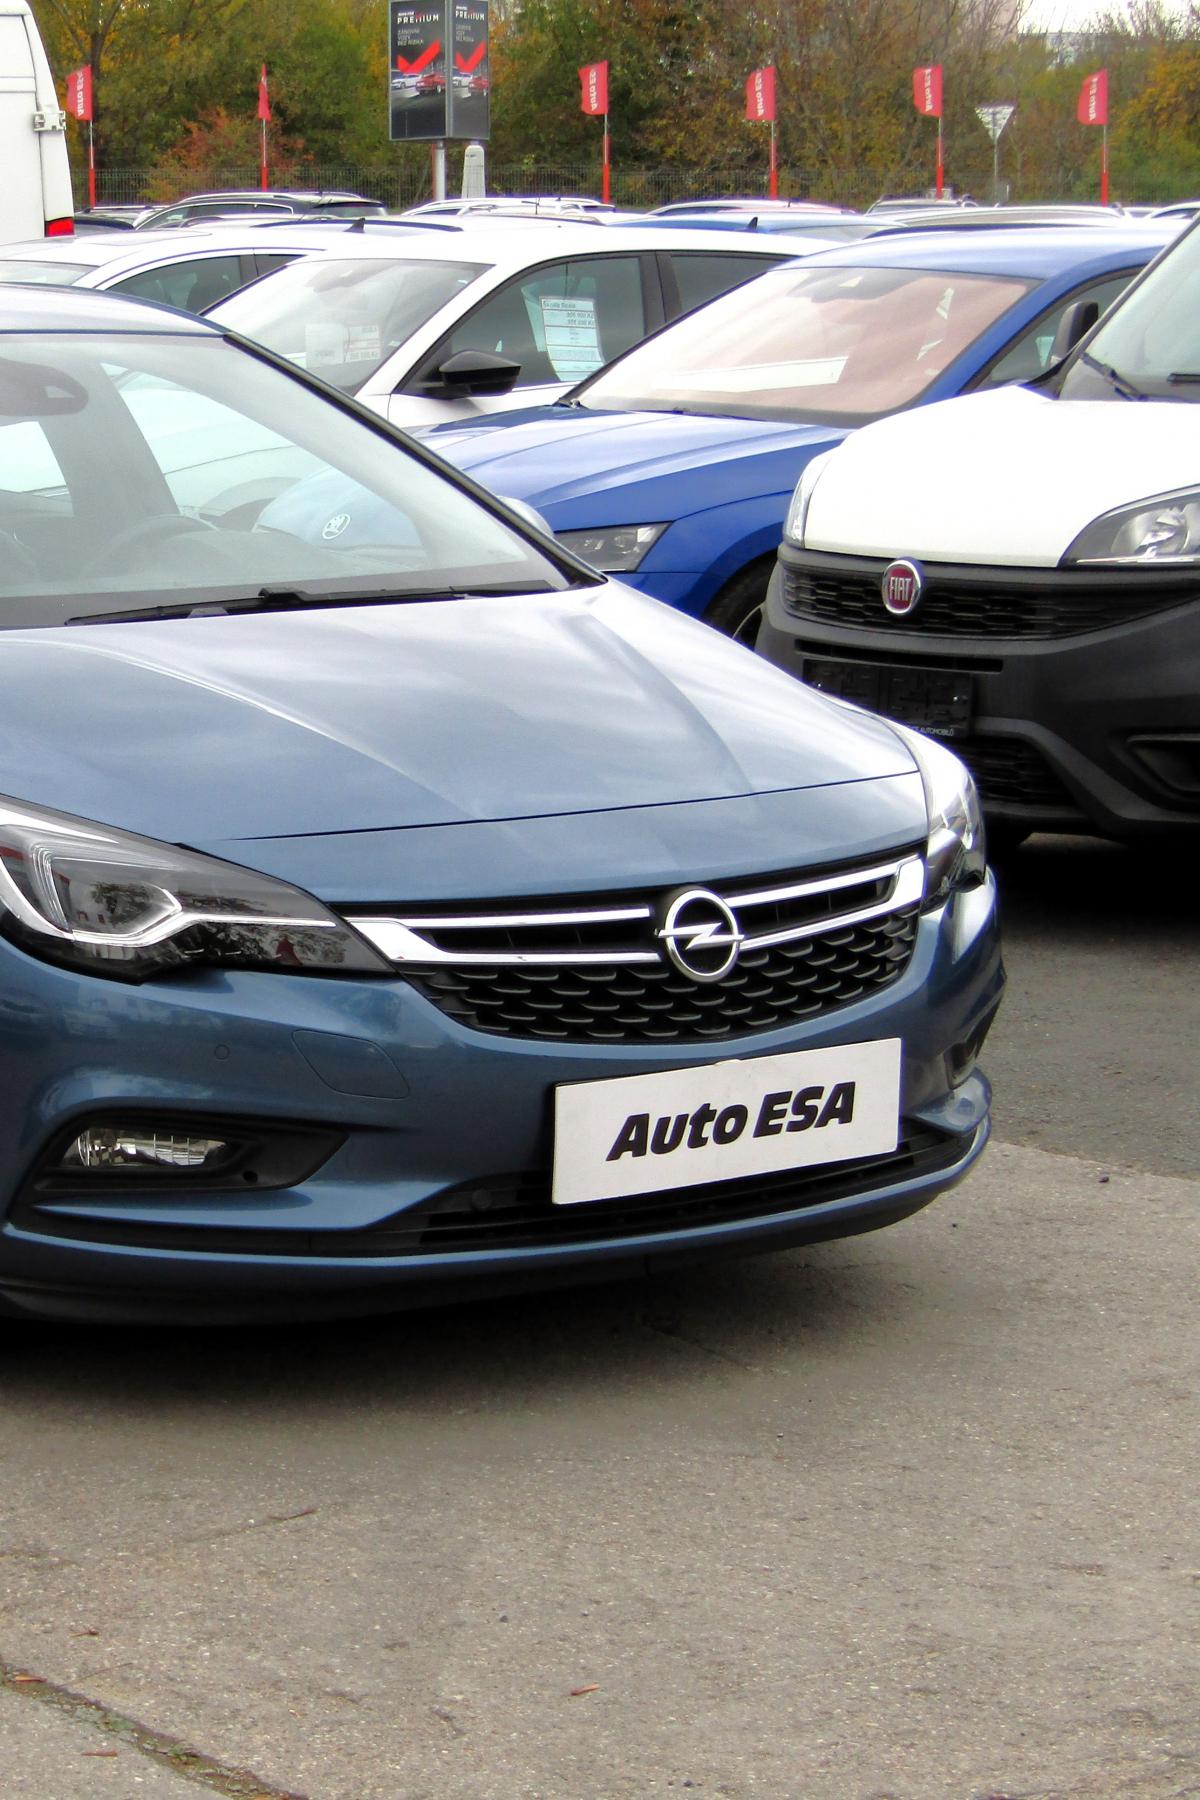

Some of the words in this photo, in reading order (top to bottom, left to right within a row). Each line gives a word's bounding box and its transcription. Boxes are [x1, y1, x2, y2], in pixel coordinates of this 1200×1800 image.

[890, 576, 912, 601] FIAT
[606, 1103, 748, 1162] Auto
[753, 1081, 856, 1138] ESA
